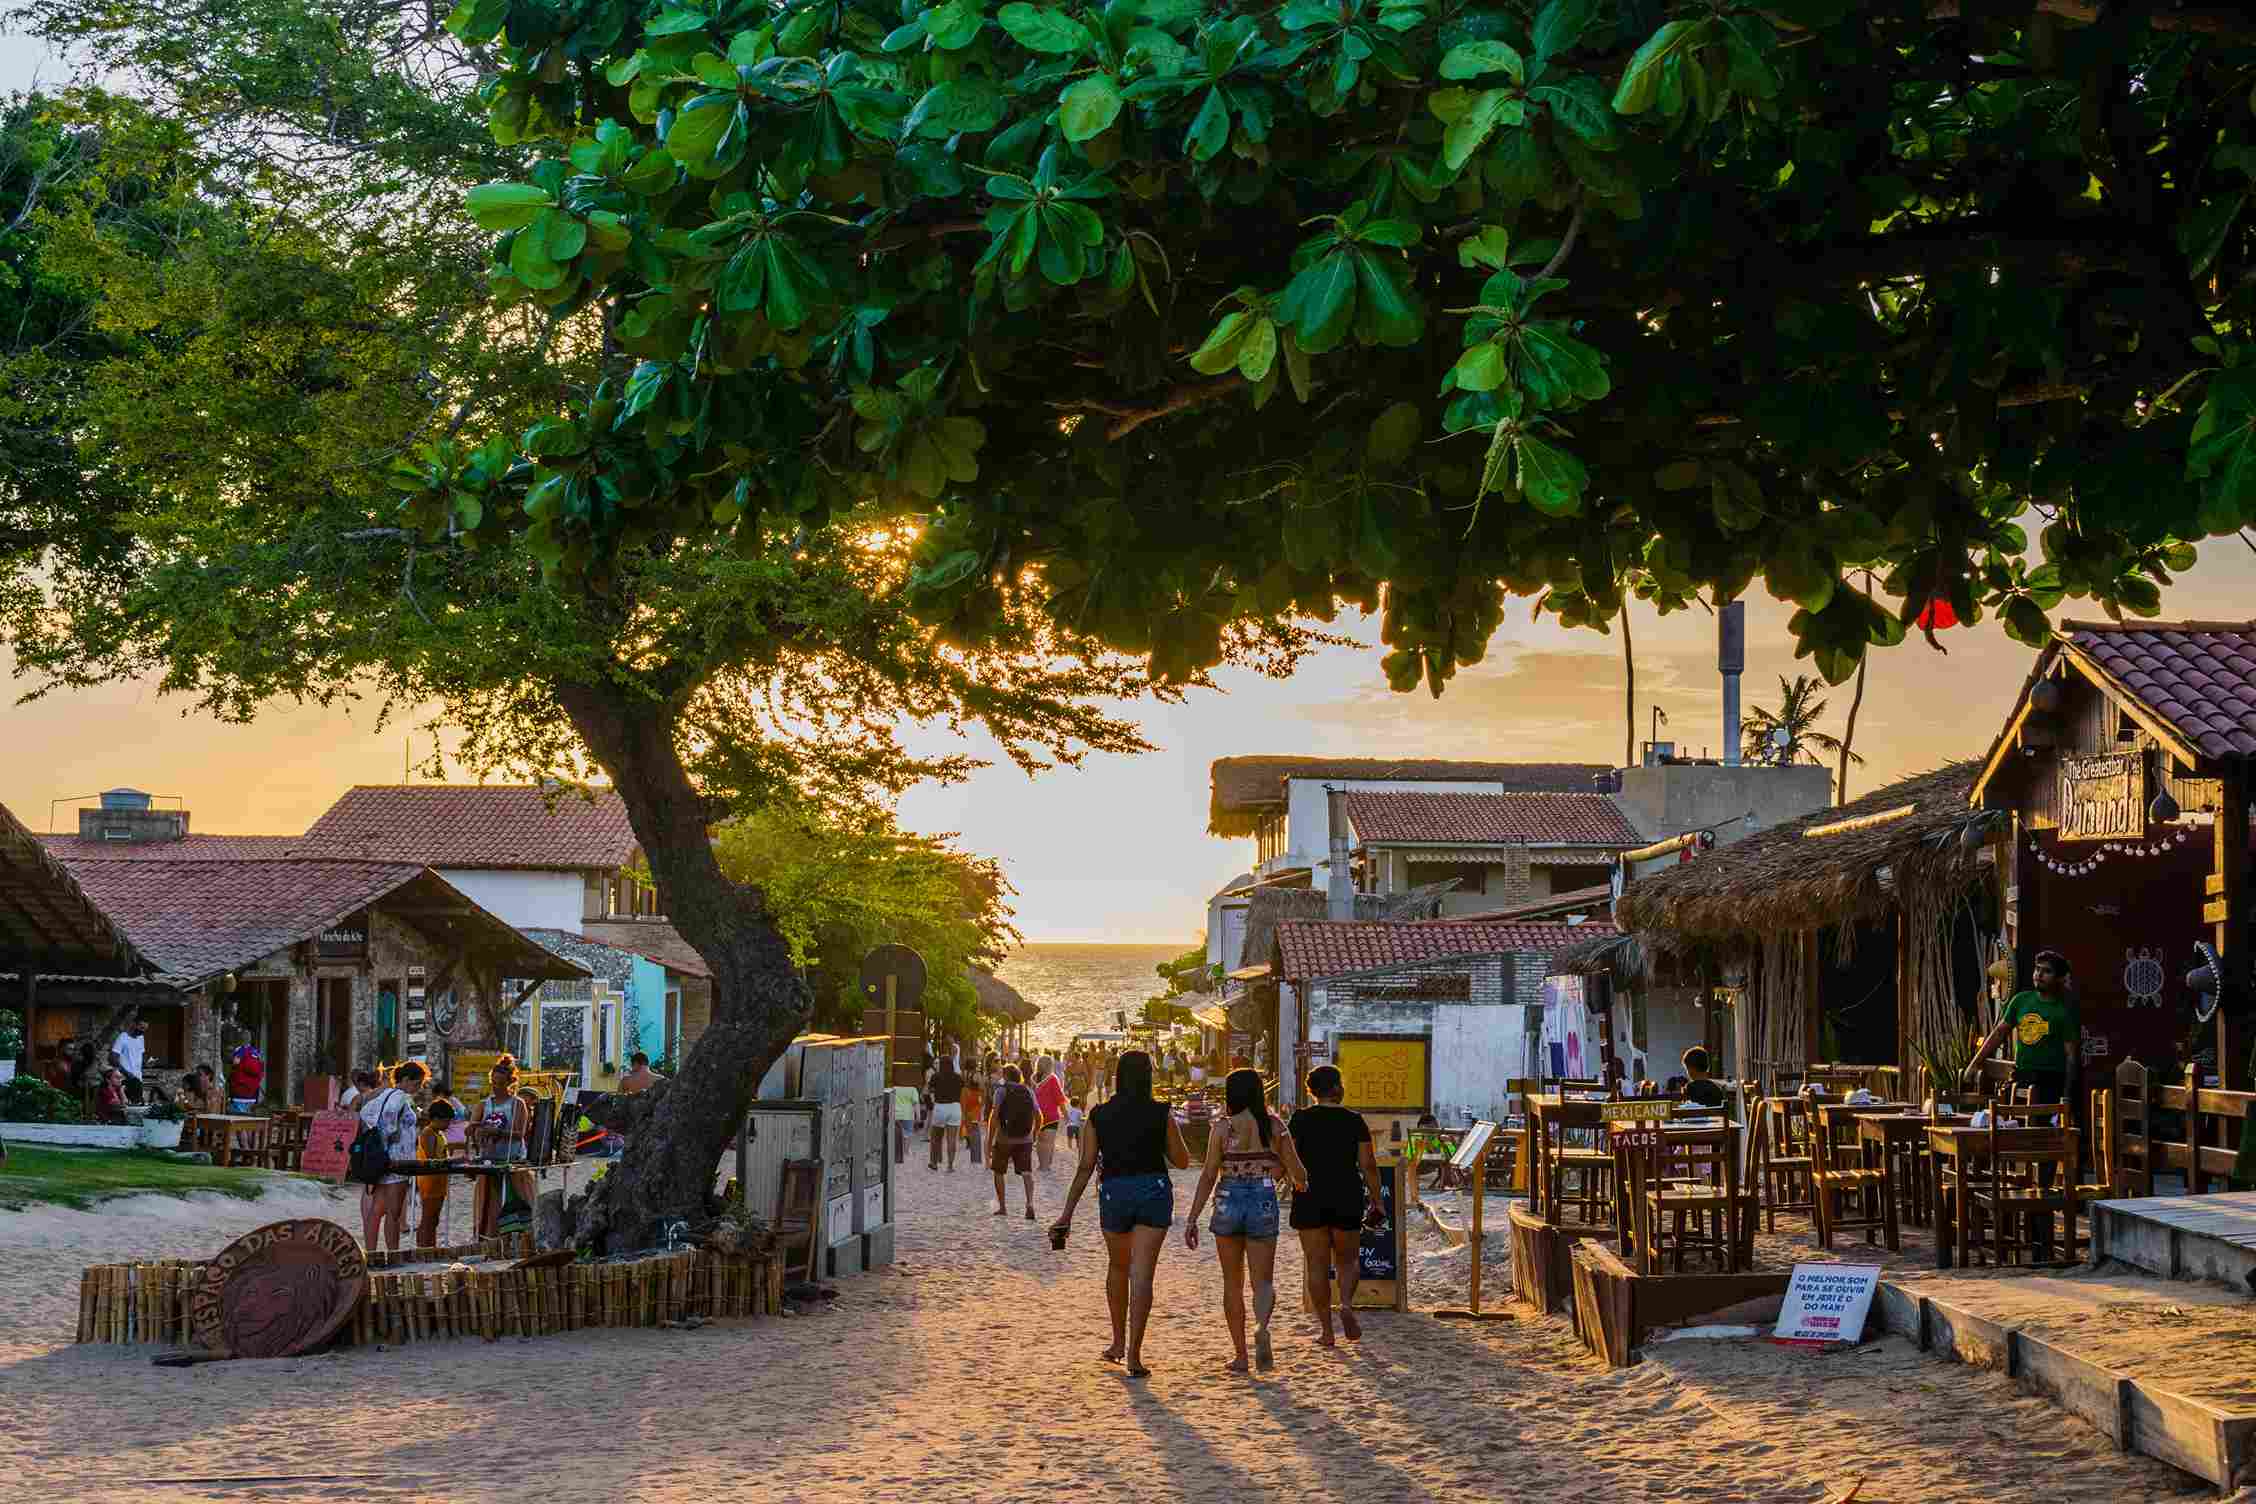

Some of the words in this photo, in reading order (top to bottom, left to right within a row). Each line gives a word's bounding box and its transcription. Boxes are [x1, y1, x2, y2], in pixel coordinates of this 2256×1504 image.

[1349, 1080, 1408, 1100] JERI
[1613, 1133, 1657, 1147] TACOS
[240, 1224, 294, 1253] DAS
[304, 1223, 361, 1279] ARTES
[1807, 1275, 1846, 1284] MELHOR
[1847, 1276, 1869, 1285] SOM
[1795, 1284, 1820, 1292] PARA
[1822, 1285, 1834, 1293] SE
[1835, 1286, 1865, 1294] OUVIR
[1801, 1293, 1815, 1301] EM
[1804, 1303, 1818, 1311] DO
